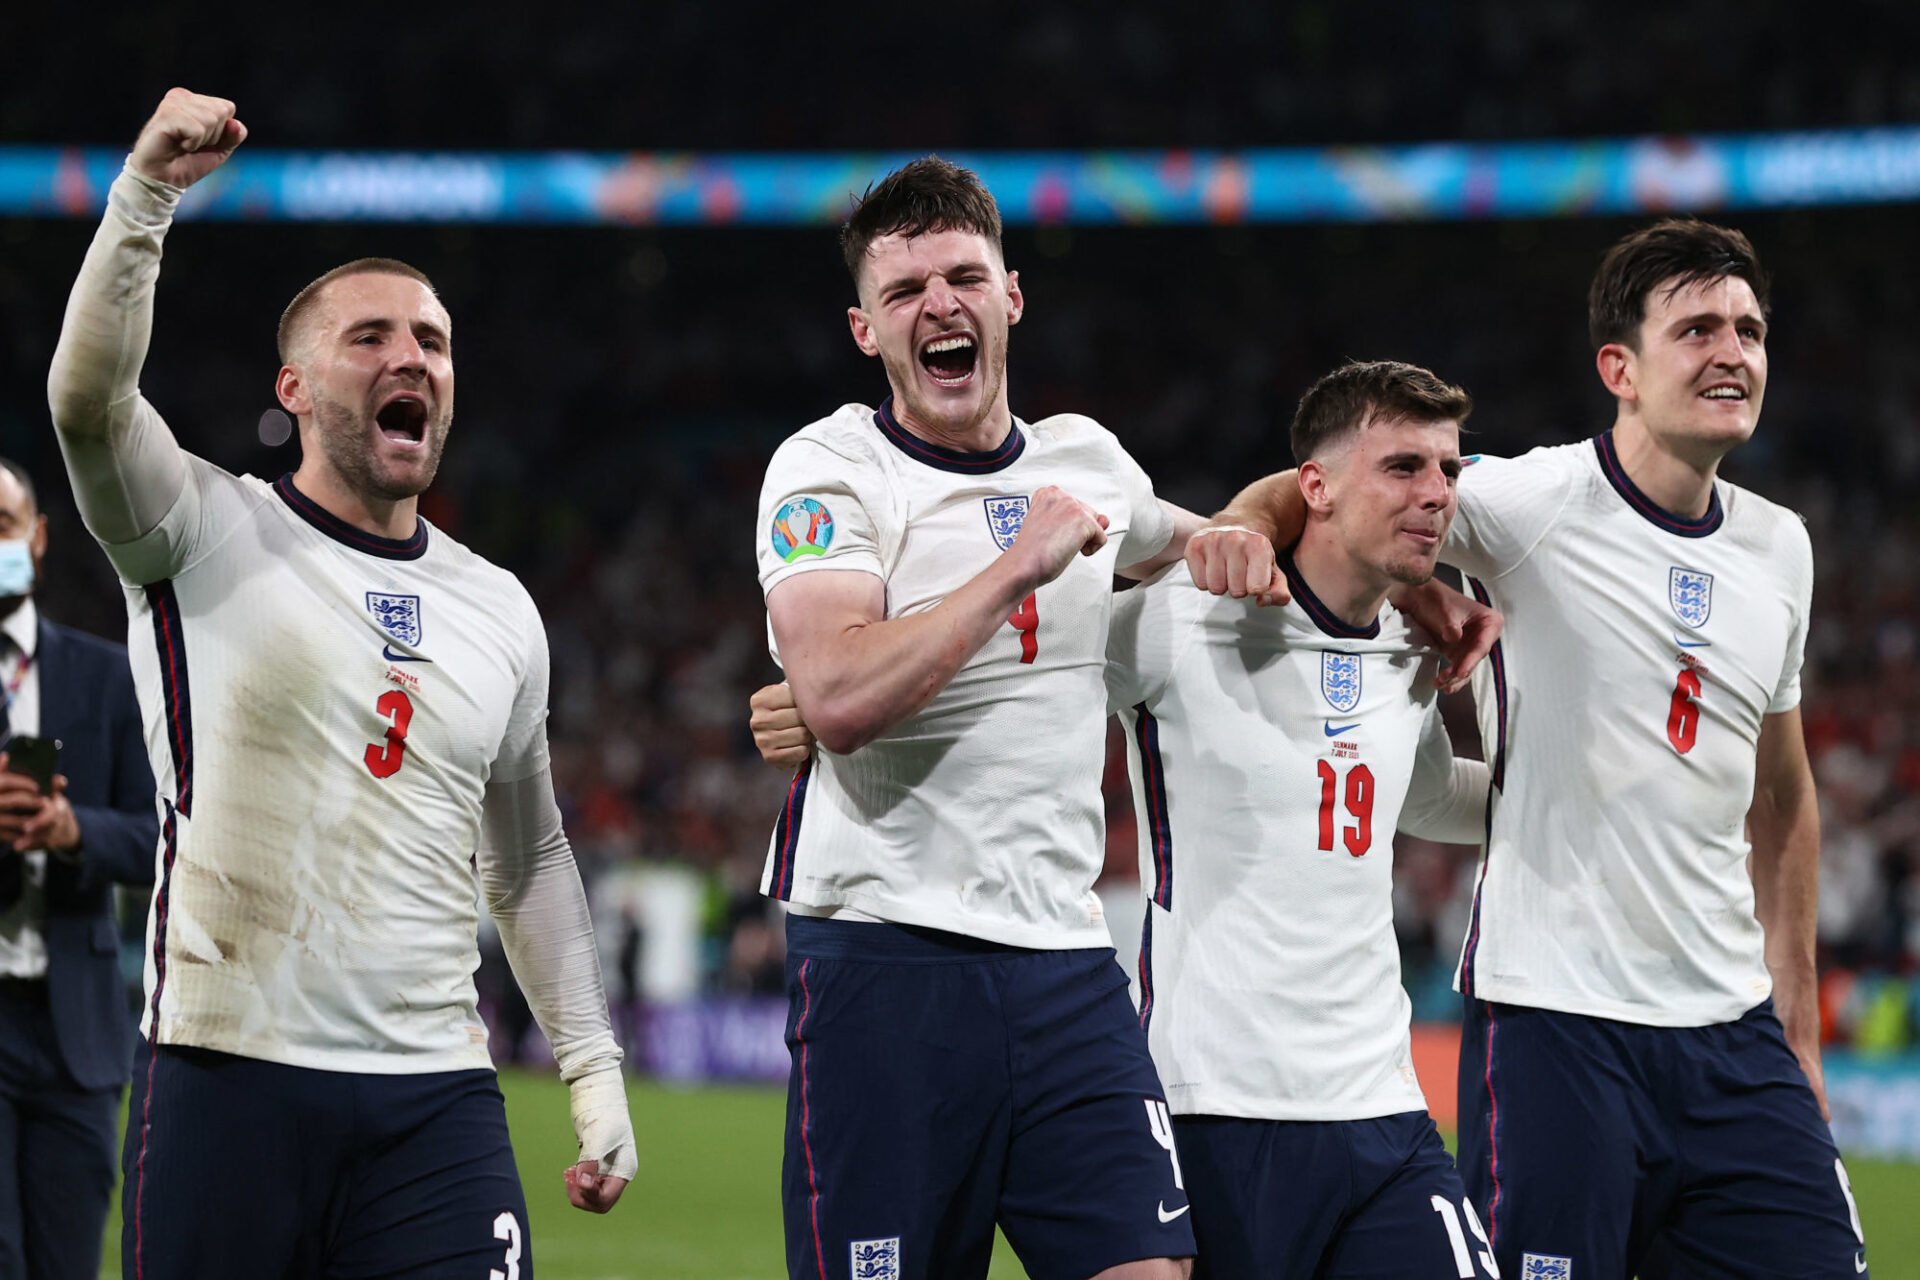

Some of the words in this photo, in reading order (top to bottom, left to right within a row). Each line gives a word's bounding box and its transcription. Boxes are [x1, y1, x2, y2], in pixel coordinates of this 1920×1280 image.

[286, 156, 501, 216] LONDON
[364, 690, 414, 779] 3
[1333, 741, 1358, 750] DENMARK
[1667, 668, 1702, 754] 6
[1317, 759, 1375, 857] 19
[1144, 1099, 1184, 1190] 4
[490, 1210, 521, 1280] 3
[1430, 1195, 1501, 1280] 19
